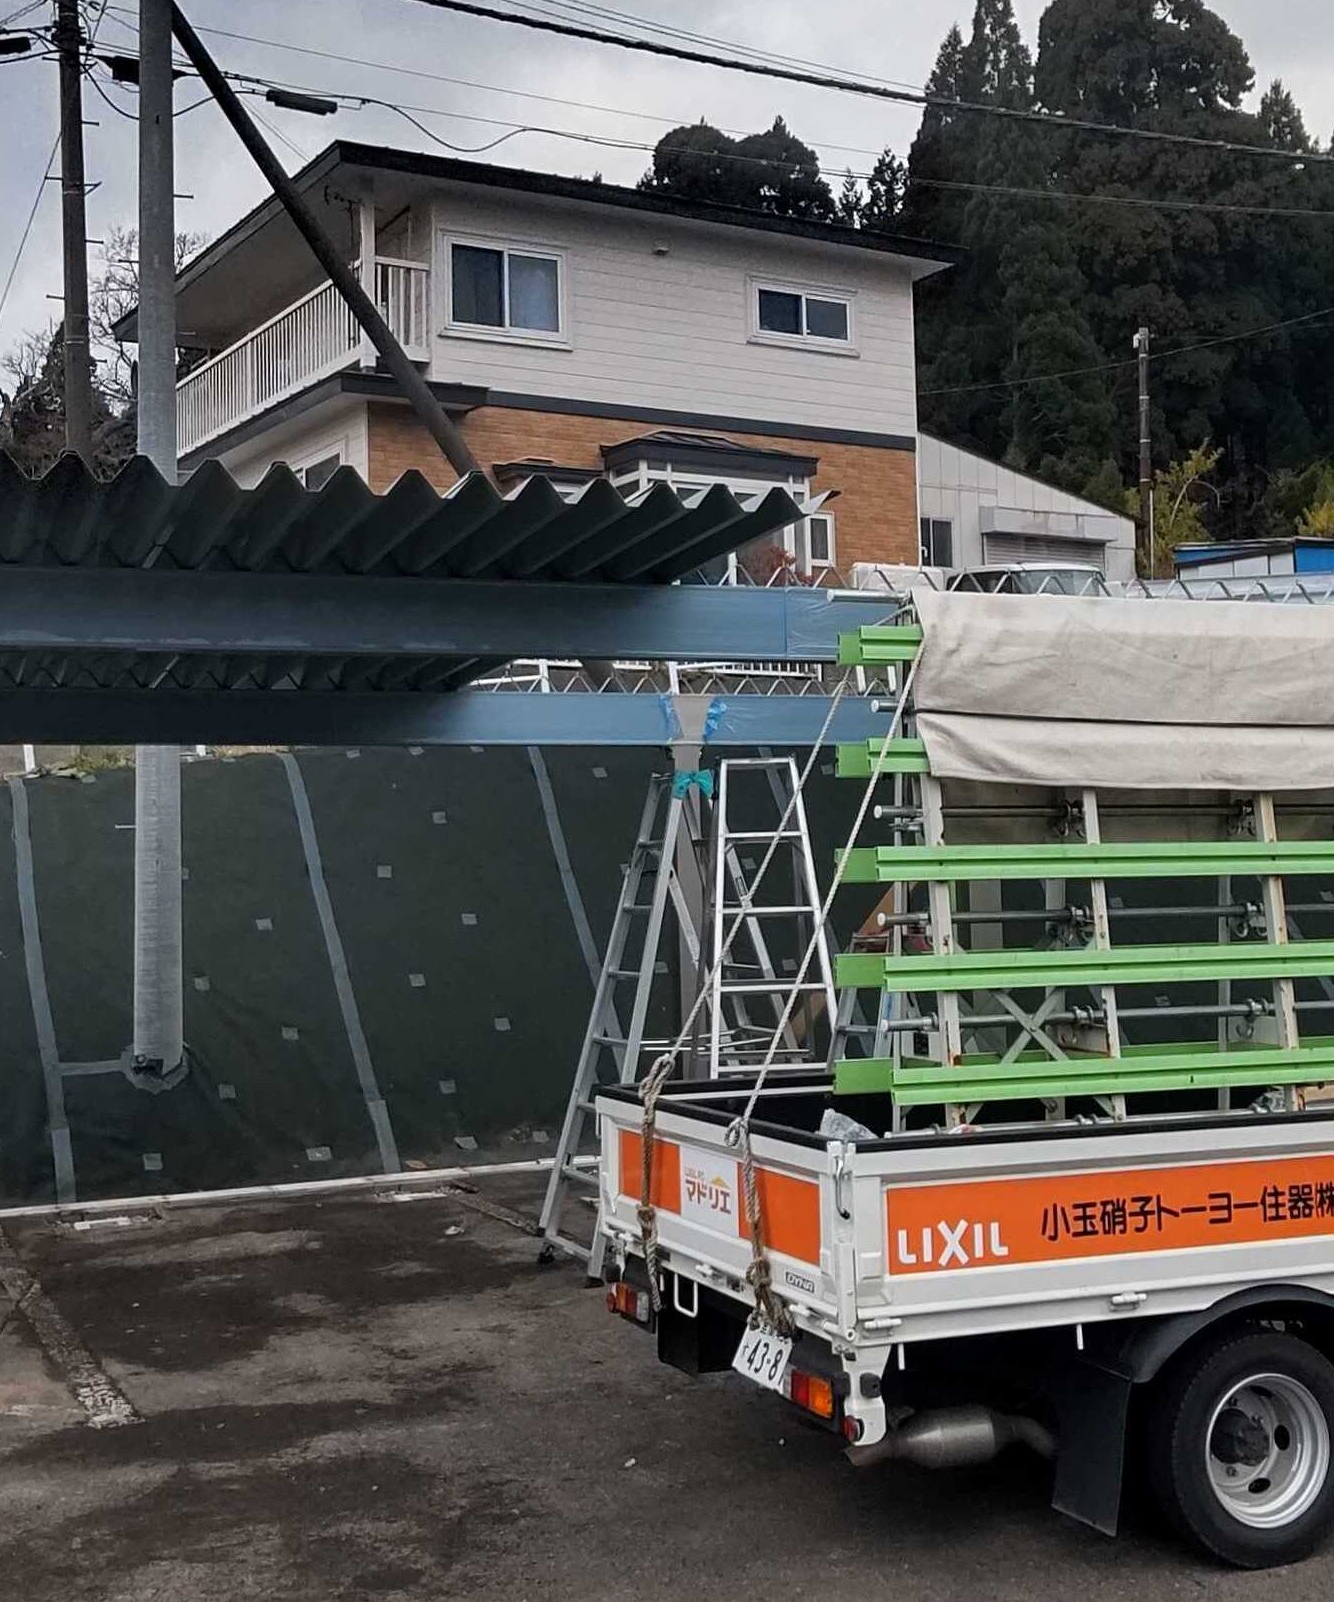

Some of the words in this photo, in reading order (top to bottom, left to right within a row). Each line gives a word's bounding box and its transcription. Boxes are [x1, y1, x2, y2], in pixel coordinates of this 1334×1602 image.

[685, 1178, 731, 1215] マドリエ
[897, 1219, 1009, 1266] LIXIL
[747, 1339, 783, 1381] 43-8
